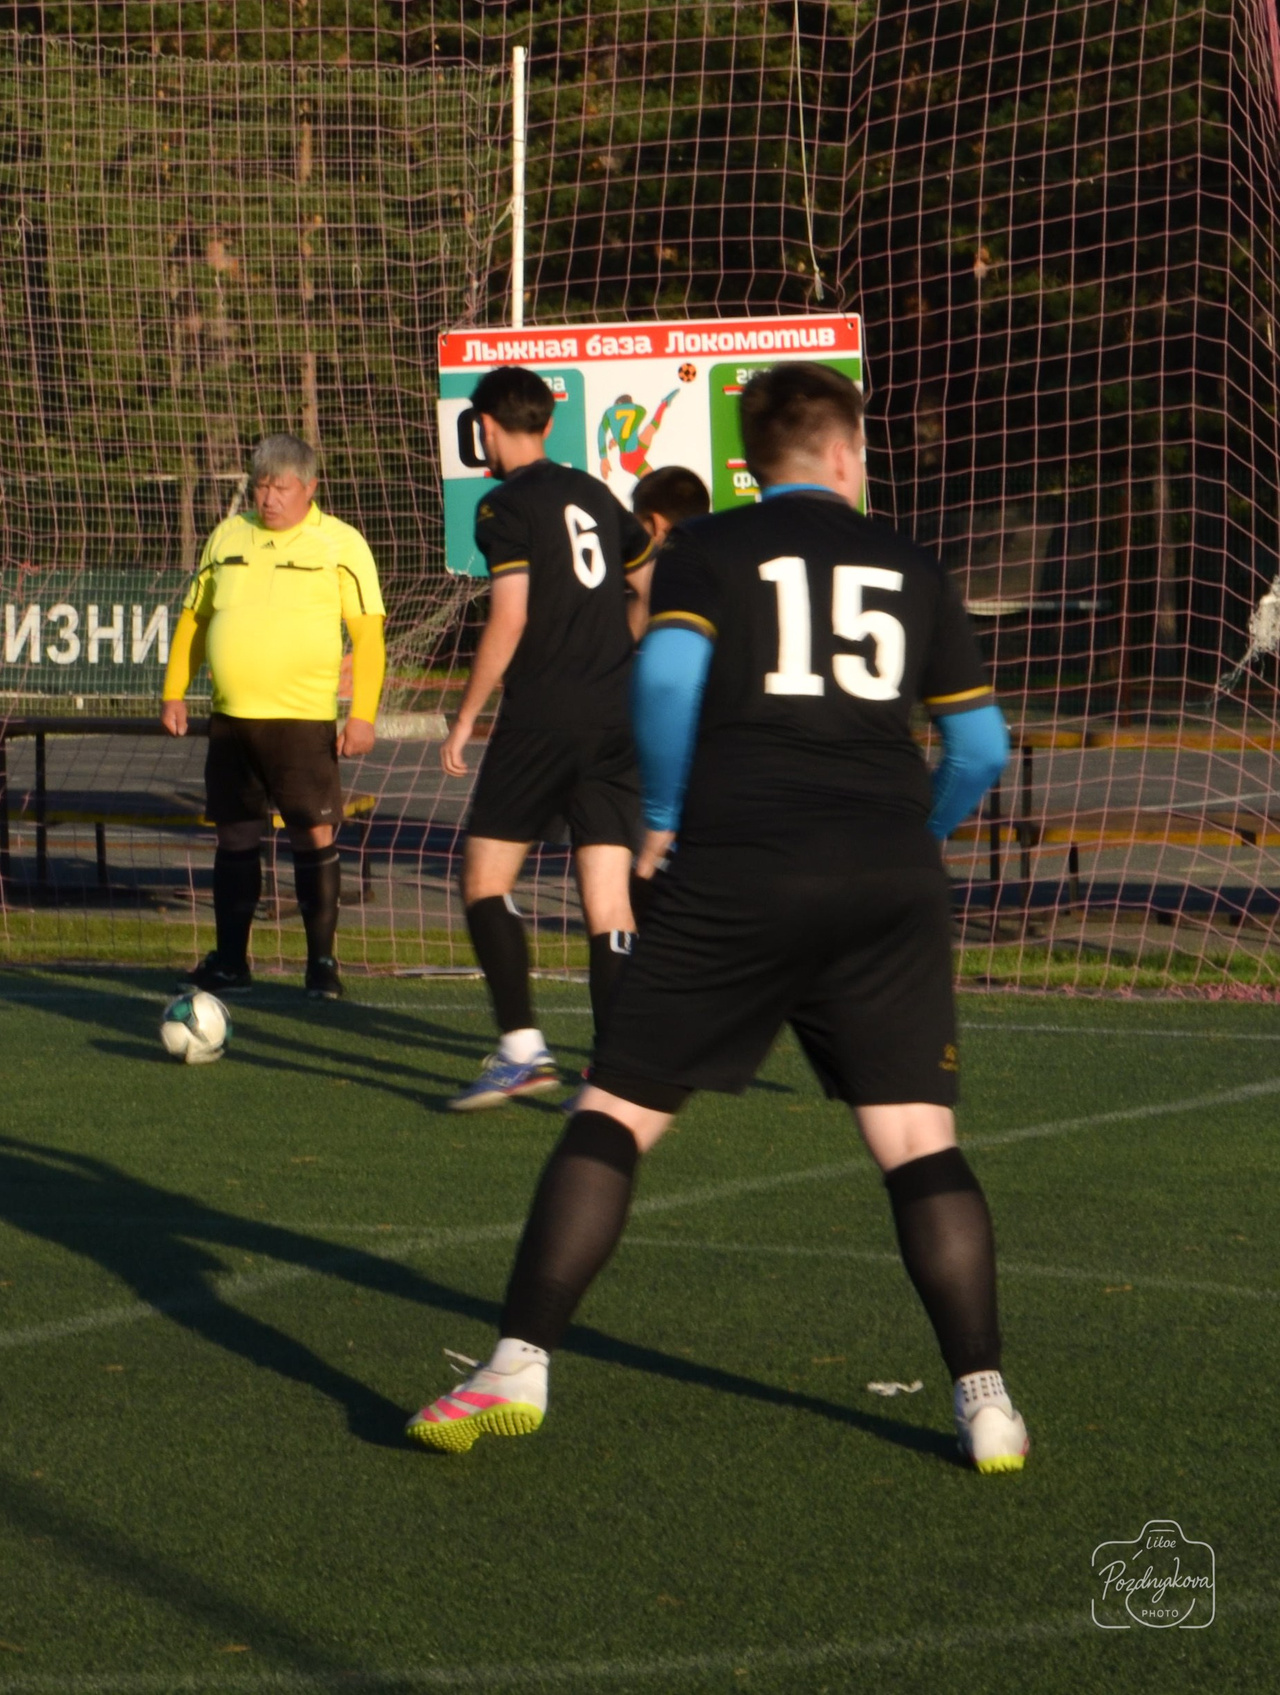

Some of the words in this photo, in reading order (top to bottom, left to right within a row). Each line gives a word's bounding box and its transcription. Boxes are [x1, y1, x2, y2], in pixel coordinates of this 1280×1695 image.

[462, 337, 578, 363] Лыжная
[586, 333, 652, 357] база
[665, 327, 836, 355] Локомотив
[615, 409, 637, 440] 7
[565, 503, 607, 589] 6
[758, 556, 906, 700] 15
